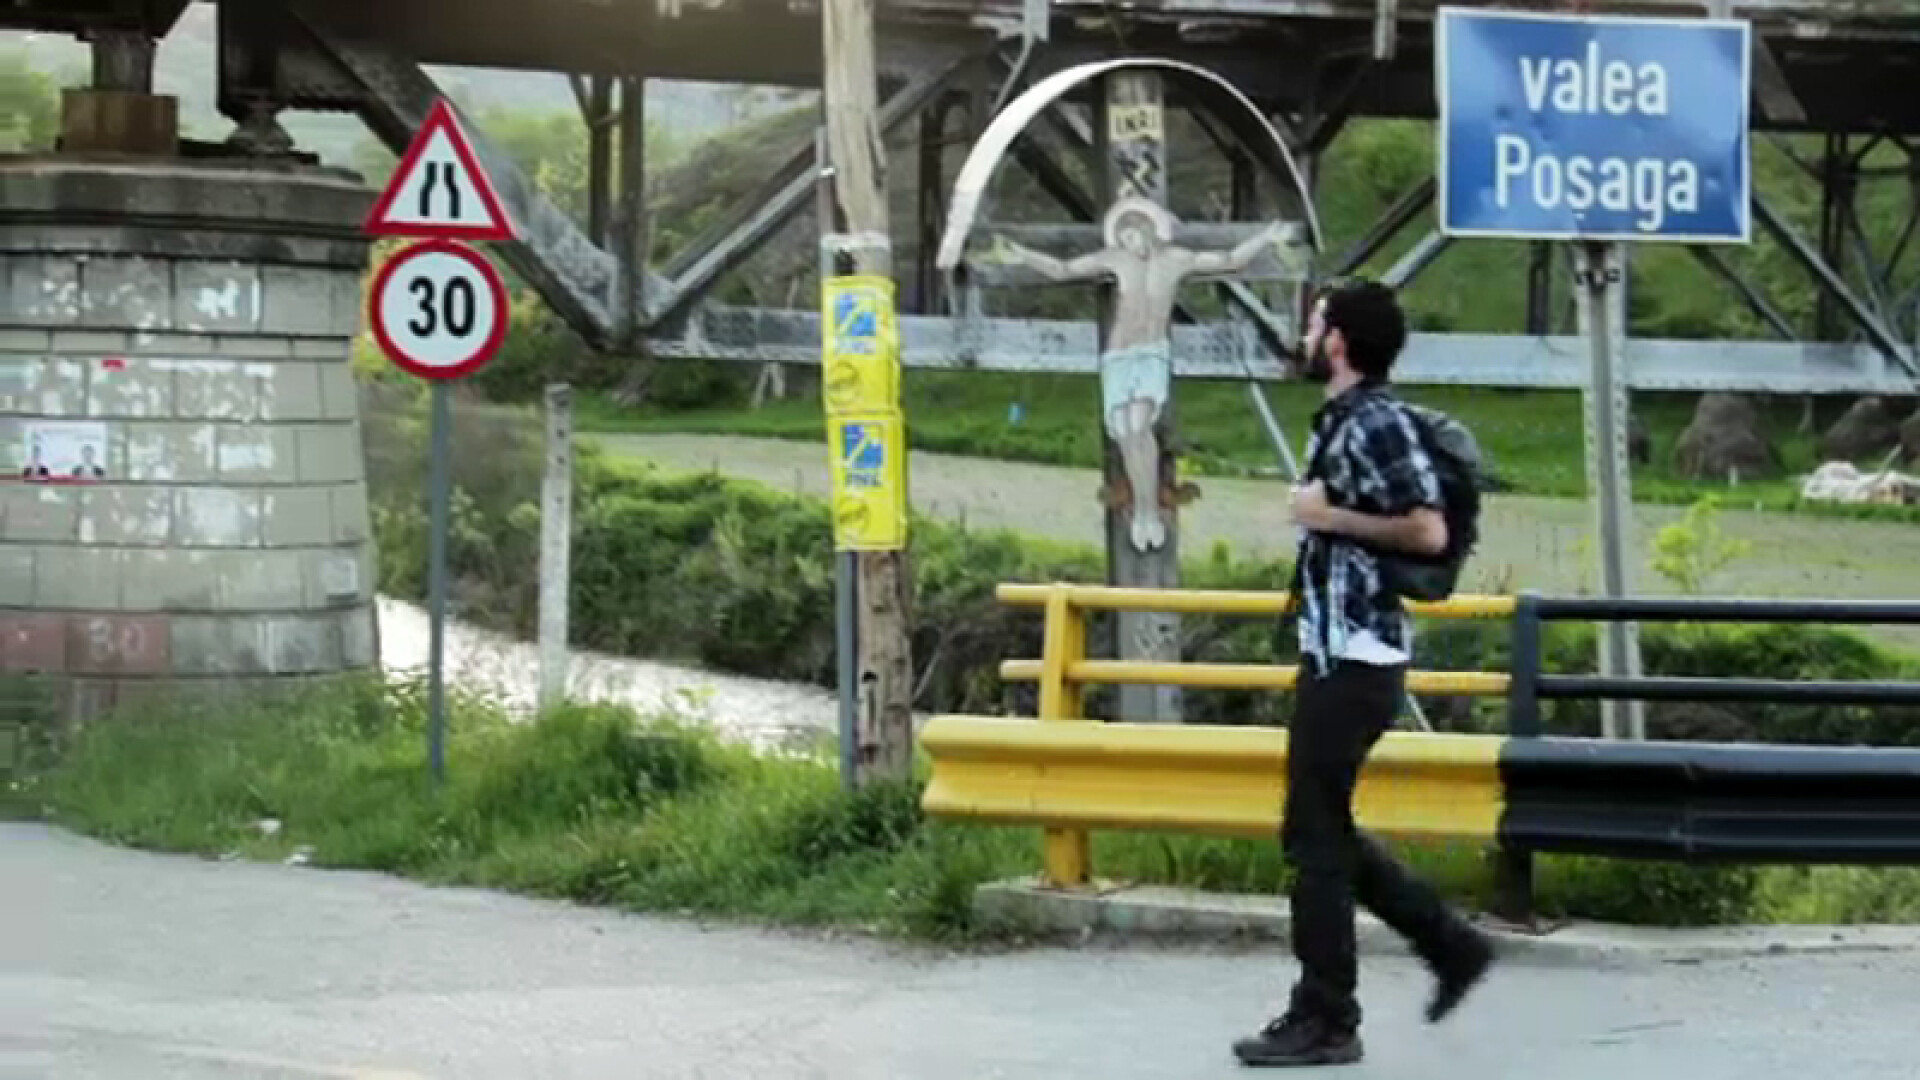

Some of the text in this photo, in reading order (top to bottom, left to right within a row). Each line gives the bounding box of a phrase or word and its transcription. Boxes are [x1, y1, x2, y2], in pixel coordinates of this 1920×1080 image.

[1519, 39, 1668, 116] valea
[1495, 133, 1699, 231] Poșaga
[407, 275, 475, 338] 30
